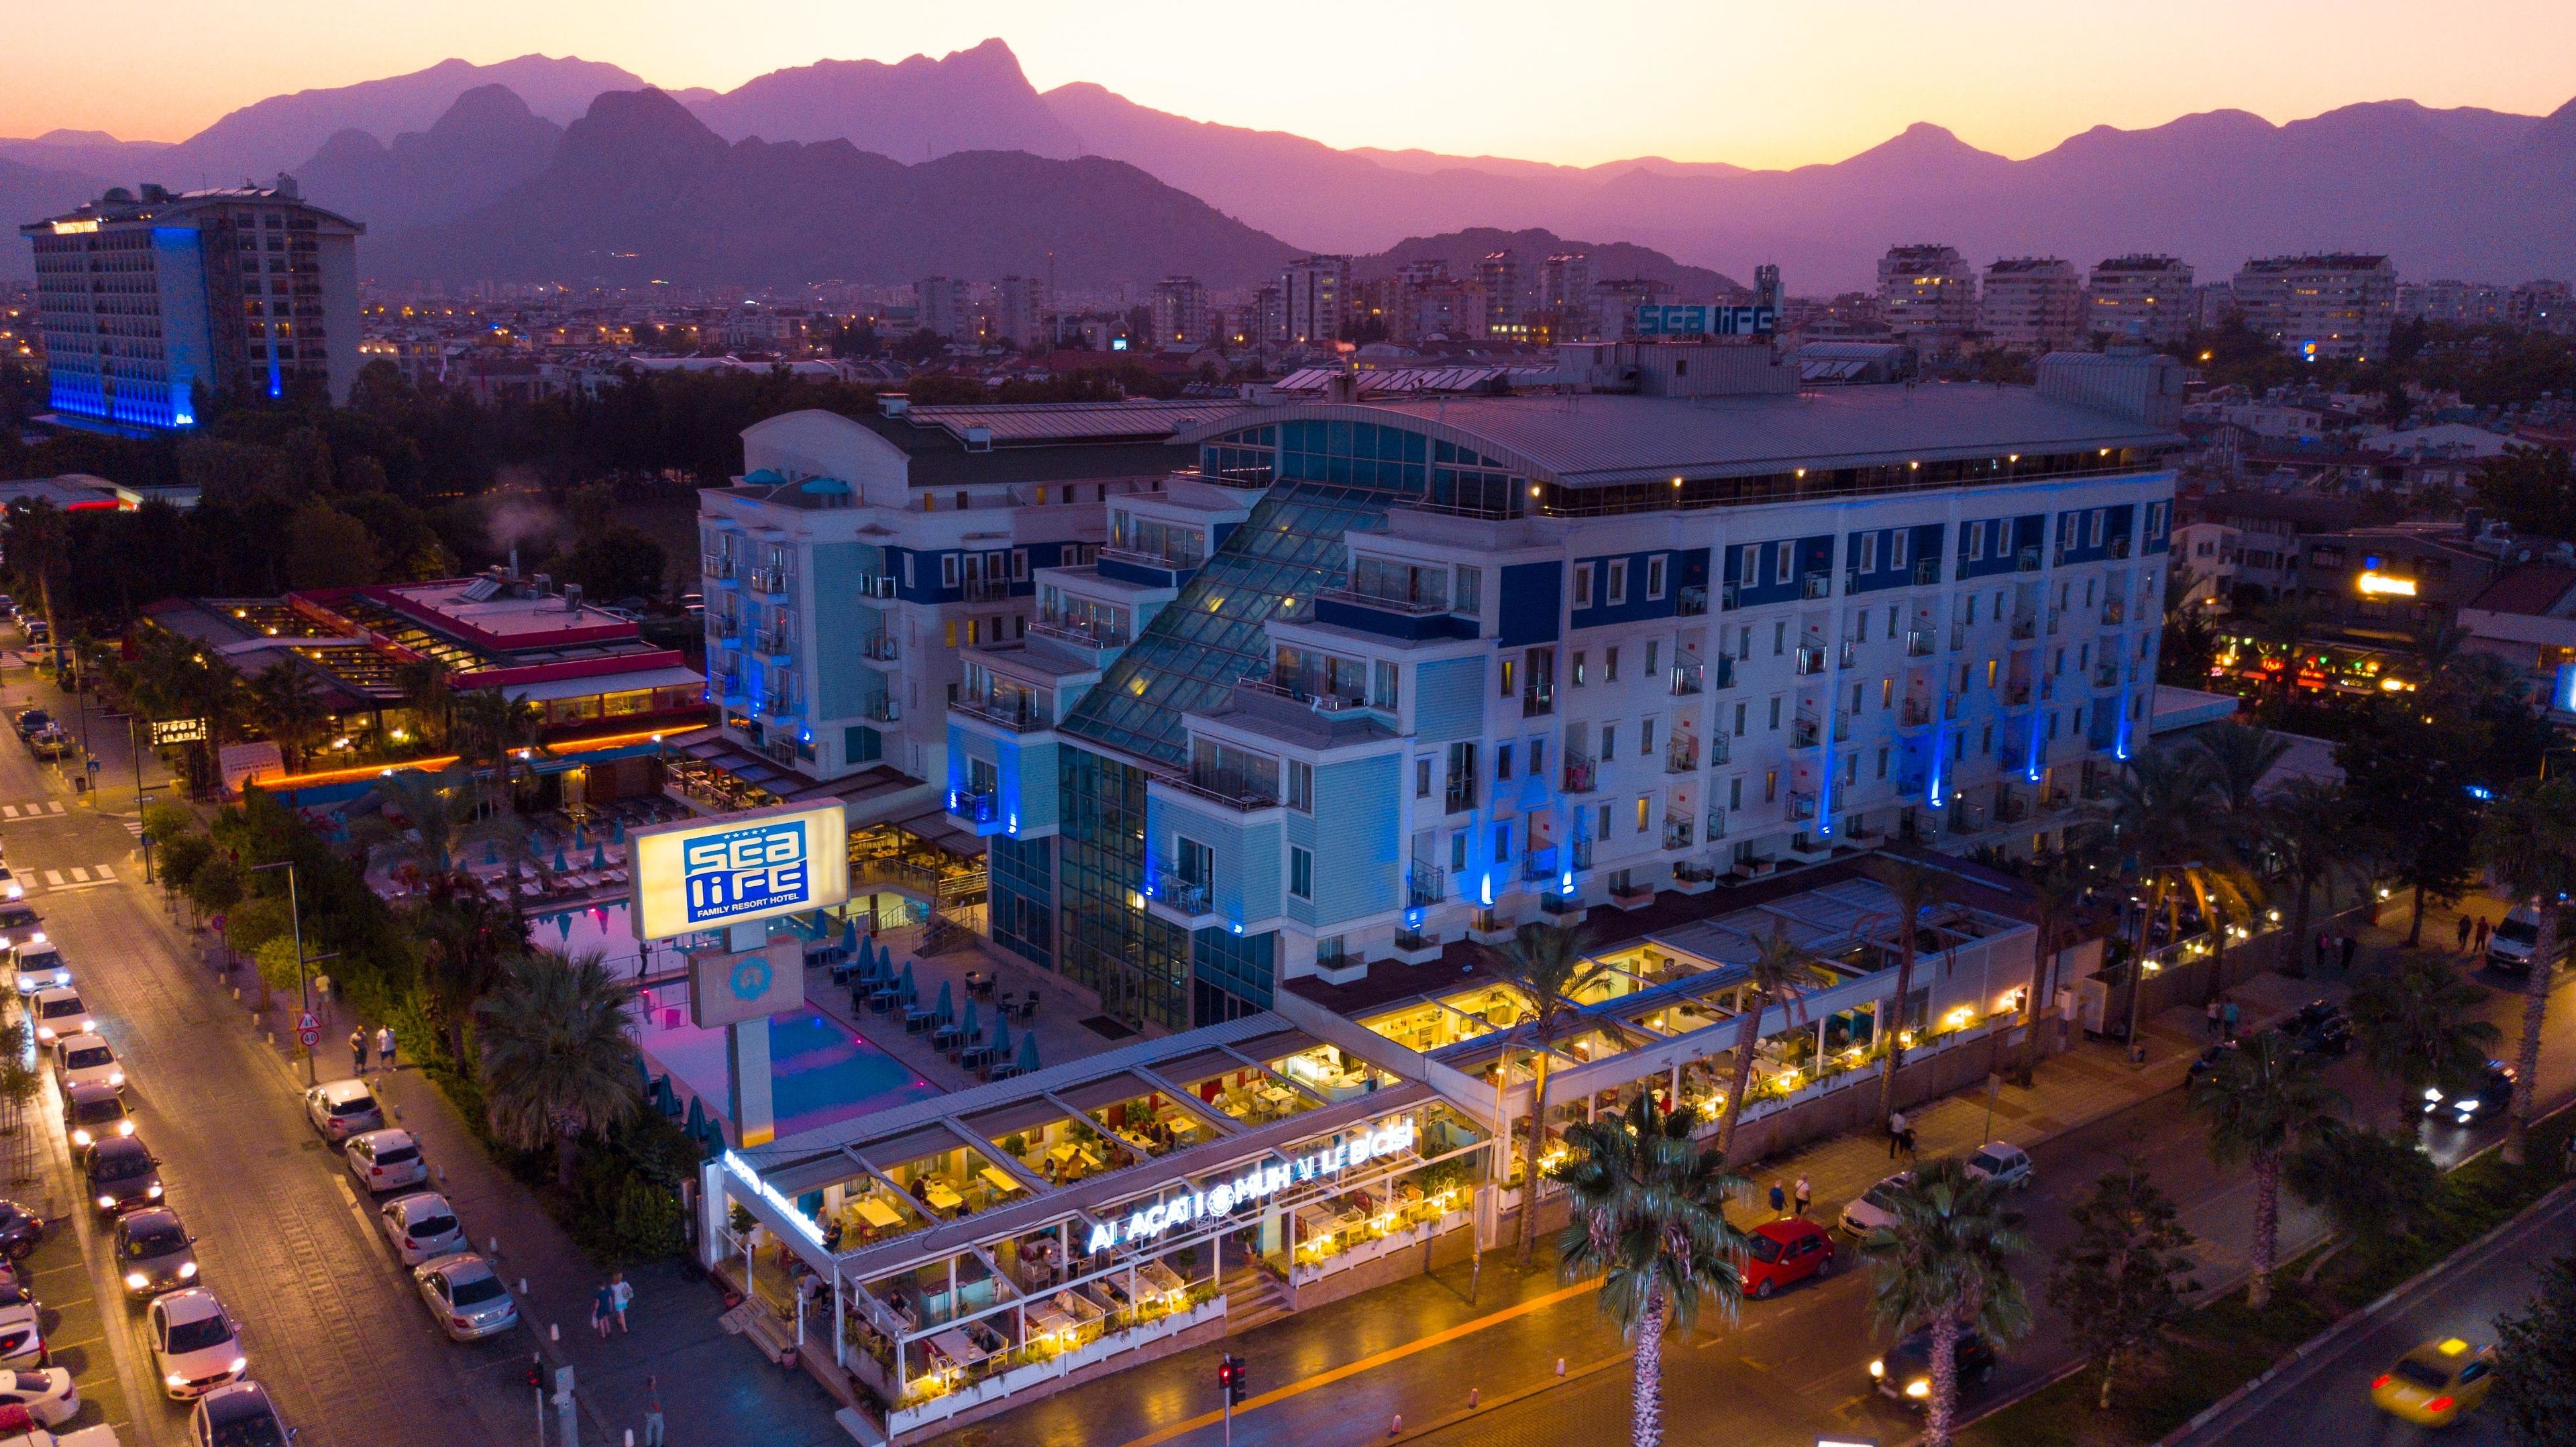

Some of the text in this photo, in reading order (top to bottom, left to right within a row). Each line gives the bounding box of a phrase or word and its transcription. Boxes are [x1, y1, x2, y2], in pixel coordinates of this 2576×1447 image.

[162, 722, 197, 732] FOOD
[698, 892, 800, 918] FAMILY RESORT HOTEL
